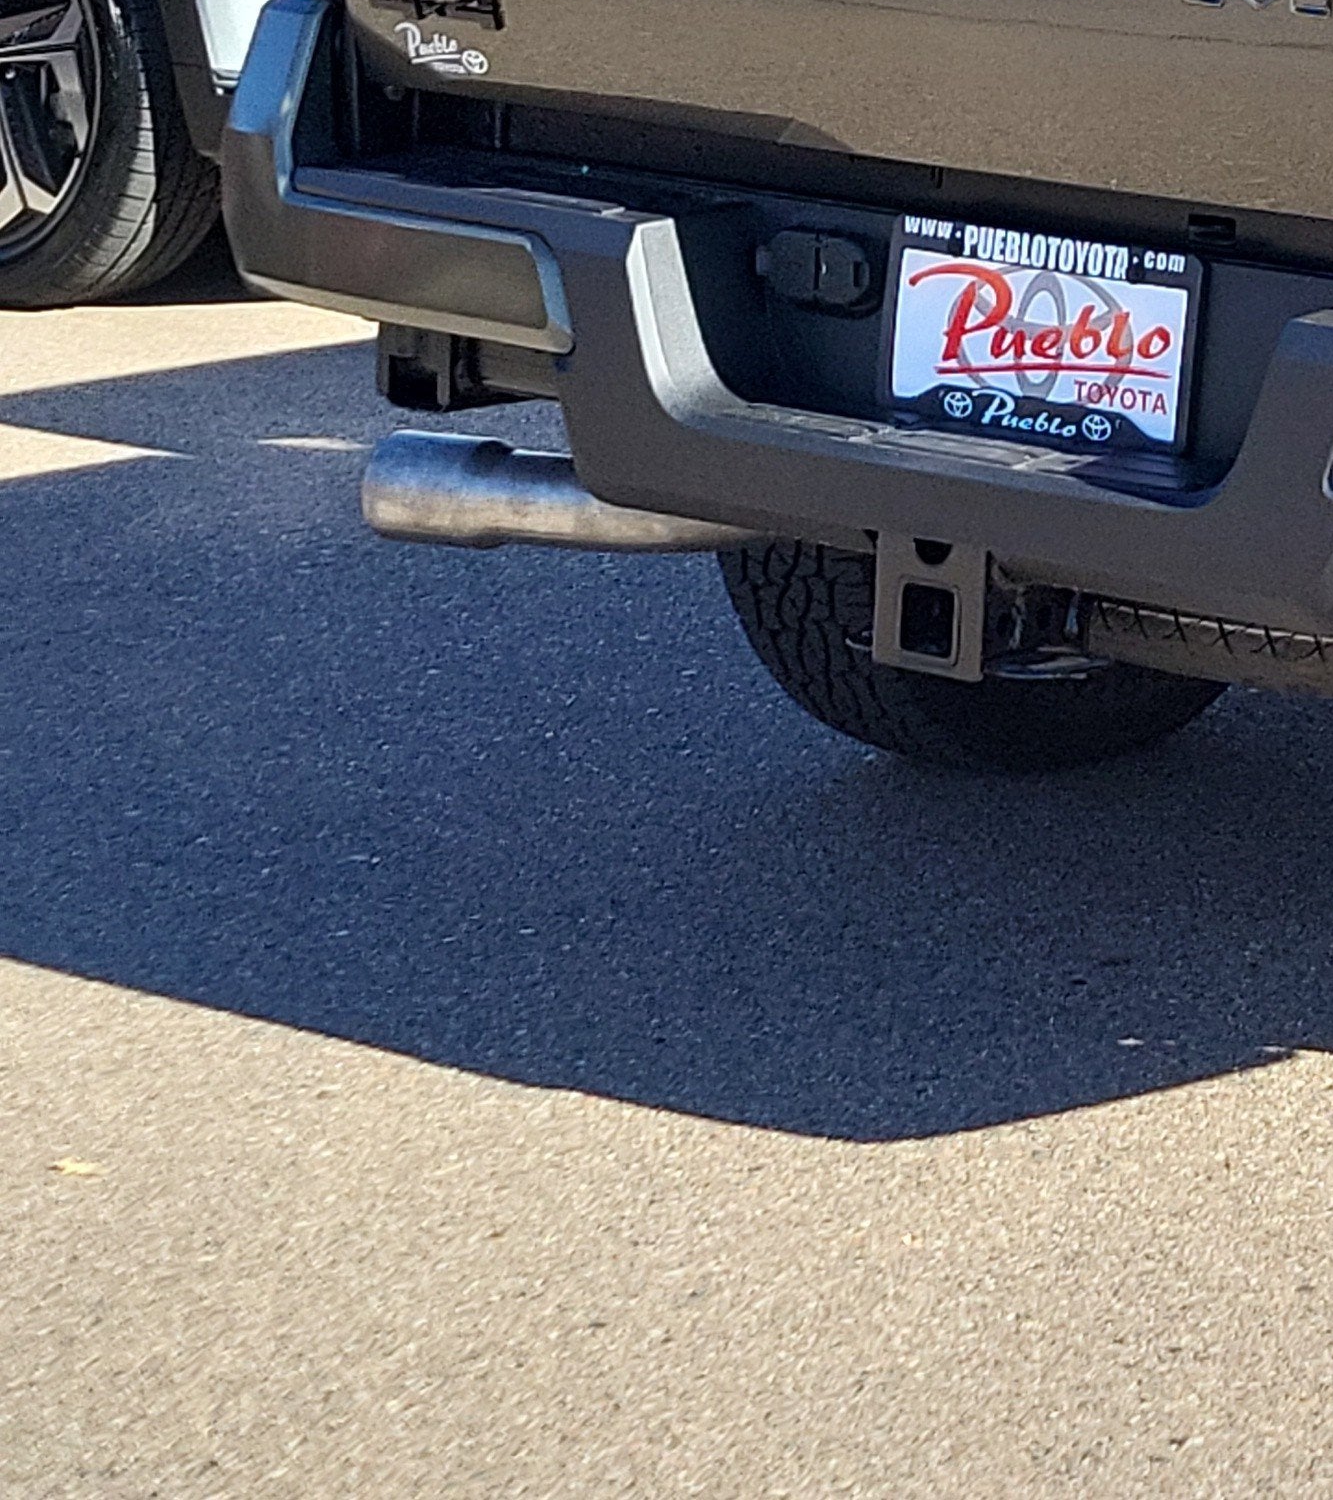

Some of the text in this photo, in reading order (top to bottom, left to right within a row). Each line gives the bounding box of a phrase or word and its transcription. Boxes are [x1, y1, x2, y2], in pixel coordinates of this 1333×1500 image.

[908, 262, 1172, 362] Pueblo
[971, 388, 1078, 438] Pueblo
[1073, 379, 1168, 416] TOYOTA
